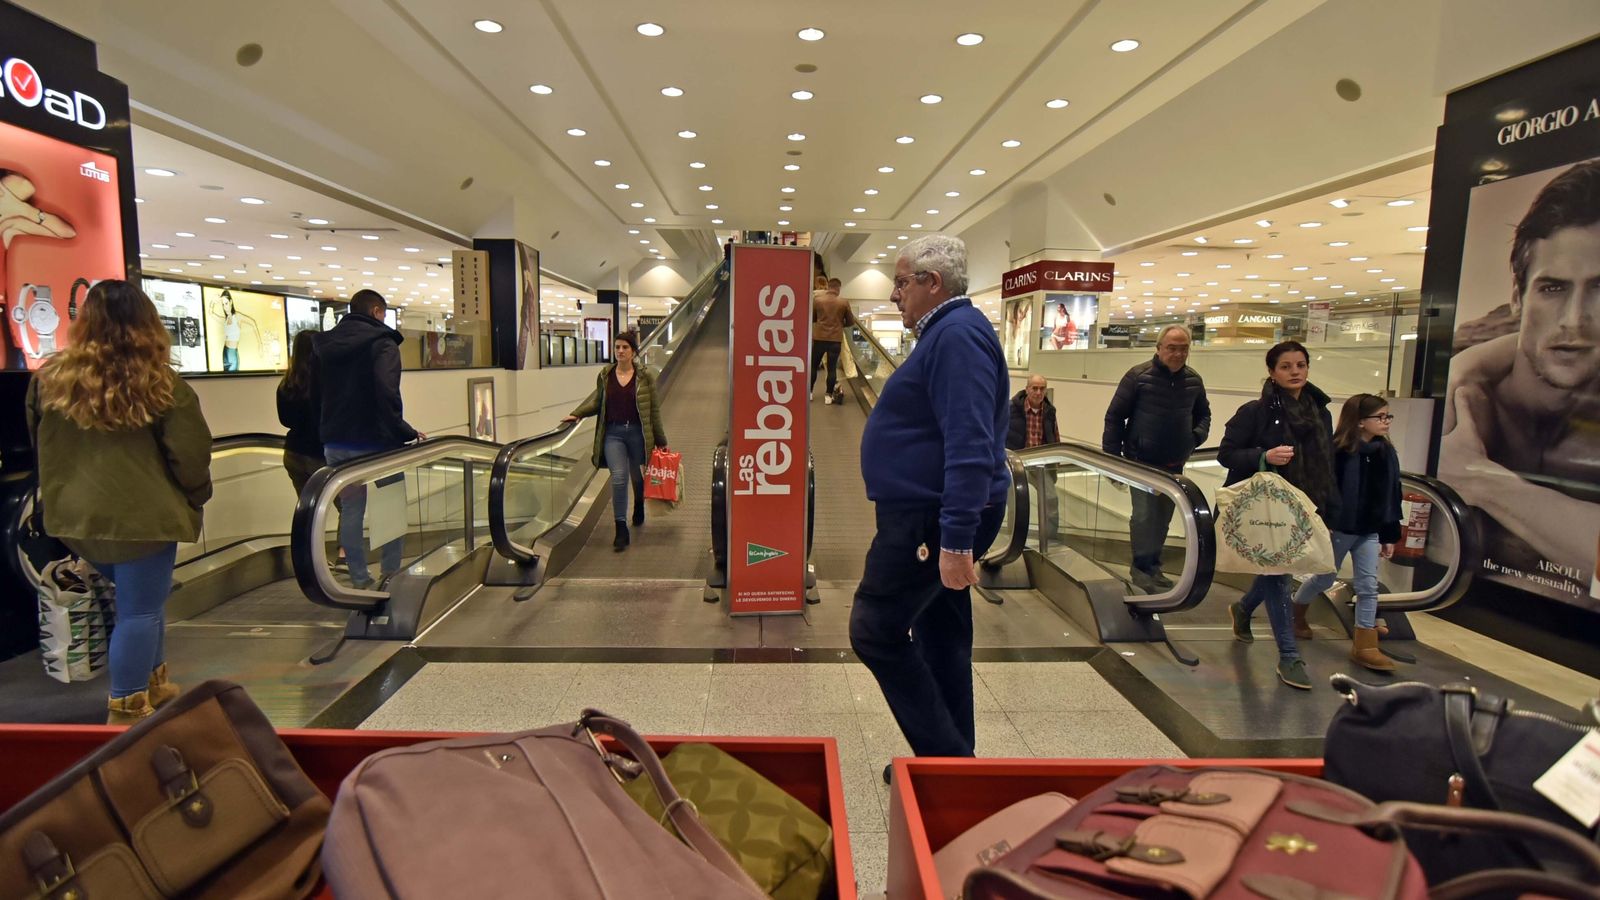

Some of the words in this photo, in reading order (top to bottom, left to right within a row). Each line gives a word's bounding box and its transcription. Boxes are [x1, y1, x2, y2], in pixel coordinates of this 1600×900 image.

[0, 57, 106, 130] OaD
[1498, 106, 1579, 145] GIORGIO
[80, 166, 110, 183] LOTUS
[1005, 270, 1037, 291] CLARINS
[1044, 270, 1111, 282] CLARINS
[1238, 314, 1282, 324] LANCASTER
[744, 285, 805, 495] rebajas
[734, 454, 754, 495] Las
[1482, 558, 1500, 572] the
[1501, 566, 1523, 579] new
[1526, 573, 1584, 599] sensuality
